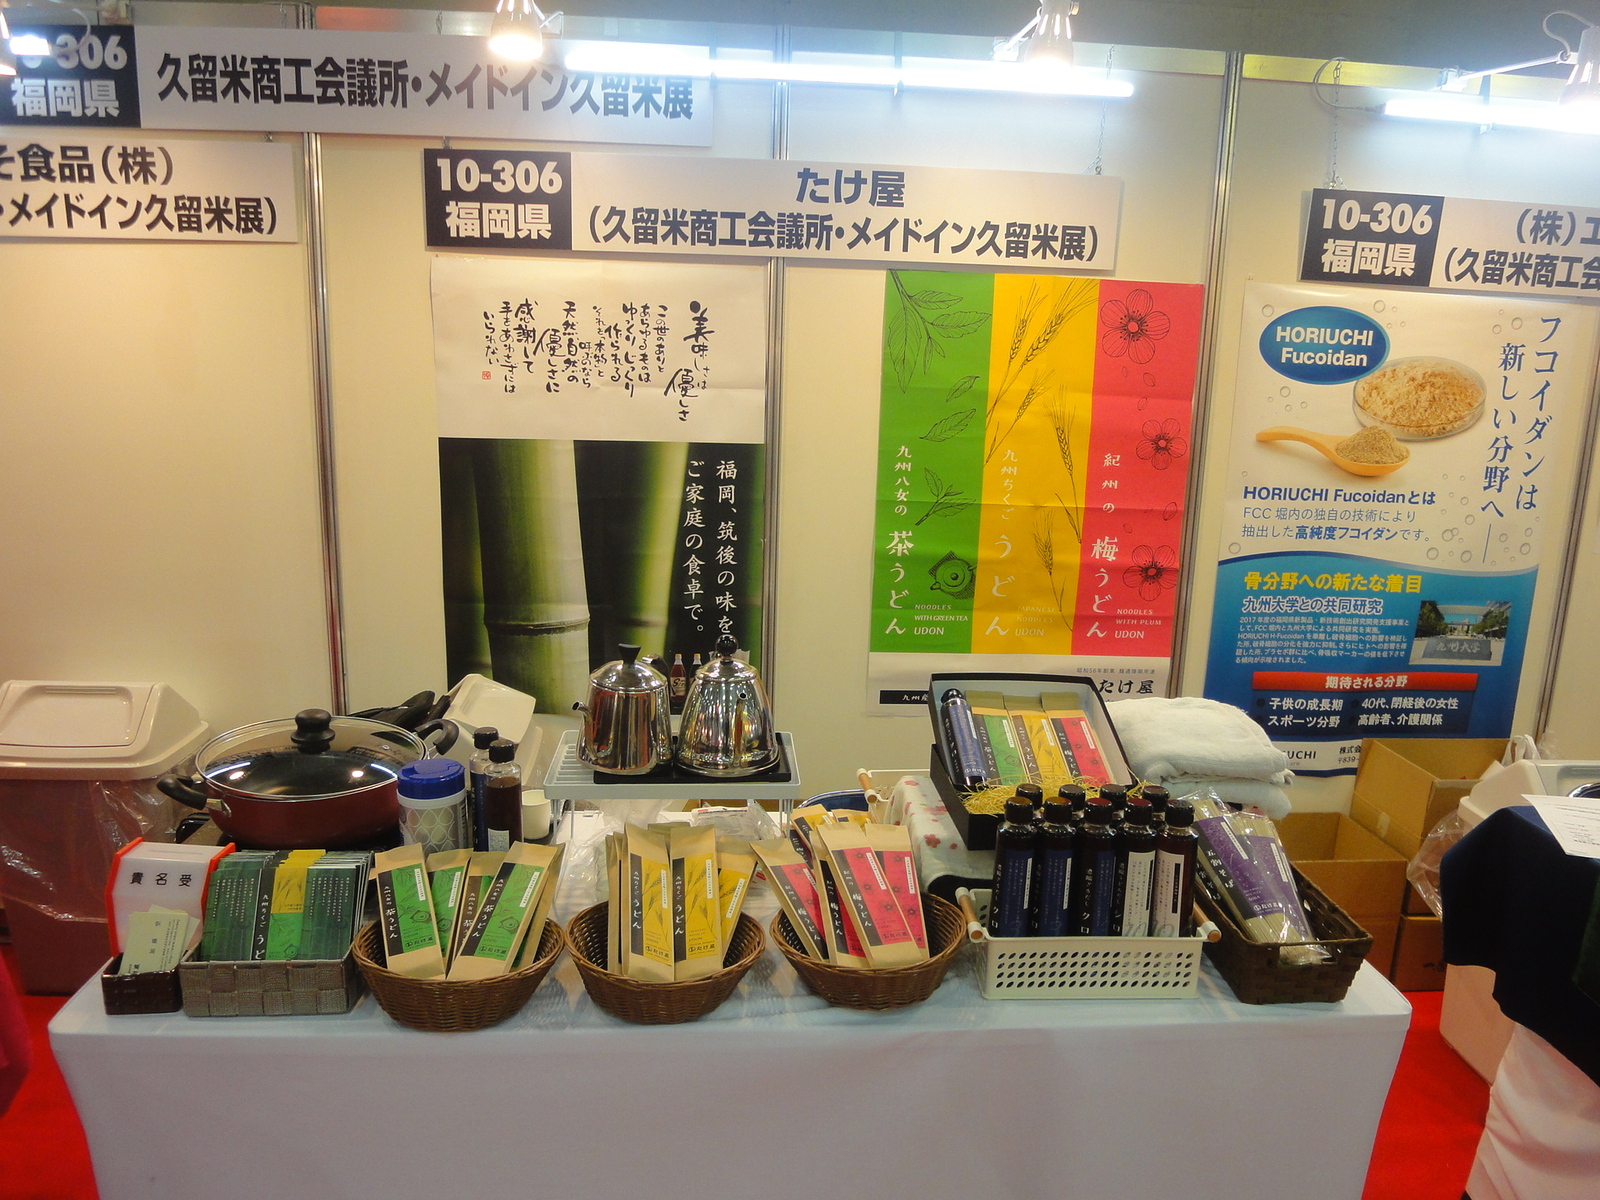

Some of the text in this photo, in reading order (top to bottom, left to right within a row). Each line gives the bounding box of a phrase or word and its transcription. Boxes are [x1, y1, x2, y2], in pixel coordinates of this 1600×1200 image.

[157, 52, 694, 120] 久留米商工会議所・メイドイン久留米展
[11, 77, 120, 118] 福岡県
[435, 158, 563, 195] 10-306
[796, 167, 906, 208] たけ屋
[444, 201, 553, 240] 福岡県
[1321, 198, 1434, 236] 10-306
[588, 206, 1100, 263] (久留米商工会議所・メイドイン久留米展)
[1321, 239, 1417, 278] 福岡県
[1275, 326, 1374, 347] HORIUCHI
[1280, 347, 1368, 367] Fucoidan
[1513, 316, 1562, 511] フコイダンは
[1480, 342, 1526, 518] 新しい分野へ
[1243, 487, 1436, 504] HORIUCHI Fucoidanとは
[1243, 507, 1271, 519] FCC
[1241, 525, 1431, 542] 抽出した高純度フコイダンです。
[682, 459, 706, 633] ご家庭の食卓で。
[714, 459, 738, 634] 福岡、筑後の味を
[1085, 452, 1121, 639] 紀州の 梅うどん
[885, 530, 914, 636] 茶うどん
[984, 534, 1016, 637] うどん
[1243, 571, 1423, 593] 骨分野への新たな着目
[1116, 608, 1153, 616] NOODLES
[1242, 597, 1383, 615] 九州大学との共同研究
[914, 614, 932, 622] WITH
[913, 626, 944, 636] UDON
[1014, 628, 1045, 636] UDON
[1114, 630, 1145, 639] UDON
[1100, 679, 1154, 694] たけ屋
[1325, 676, 1408, 690] 期待される分野
[1269, 698, 1343, 711] 子供の成長期
[1361, 697, 1459, 710] 40代、閉経後の女性
[1268, 716, 1341, 728] スポーツ分野
[1357, 713, 1443, 727] 高齢者、介護関係
